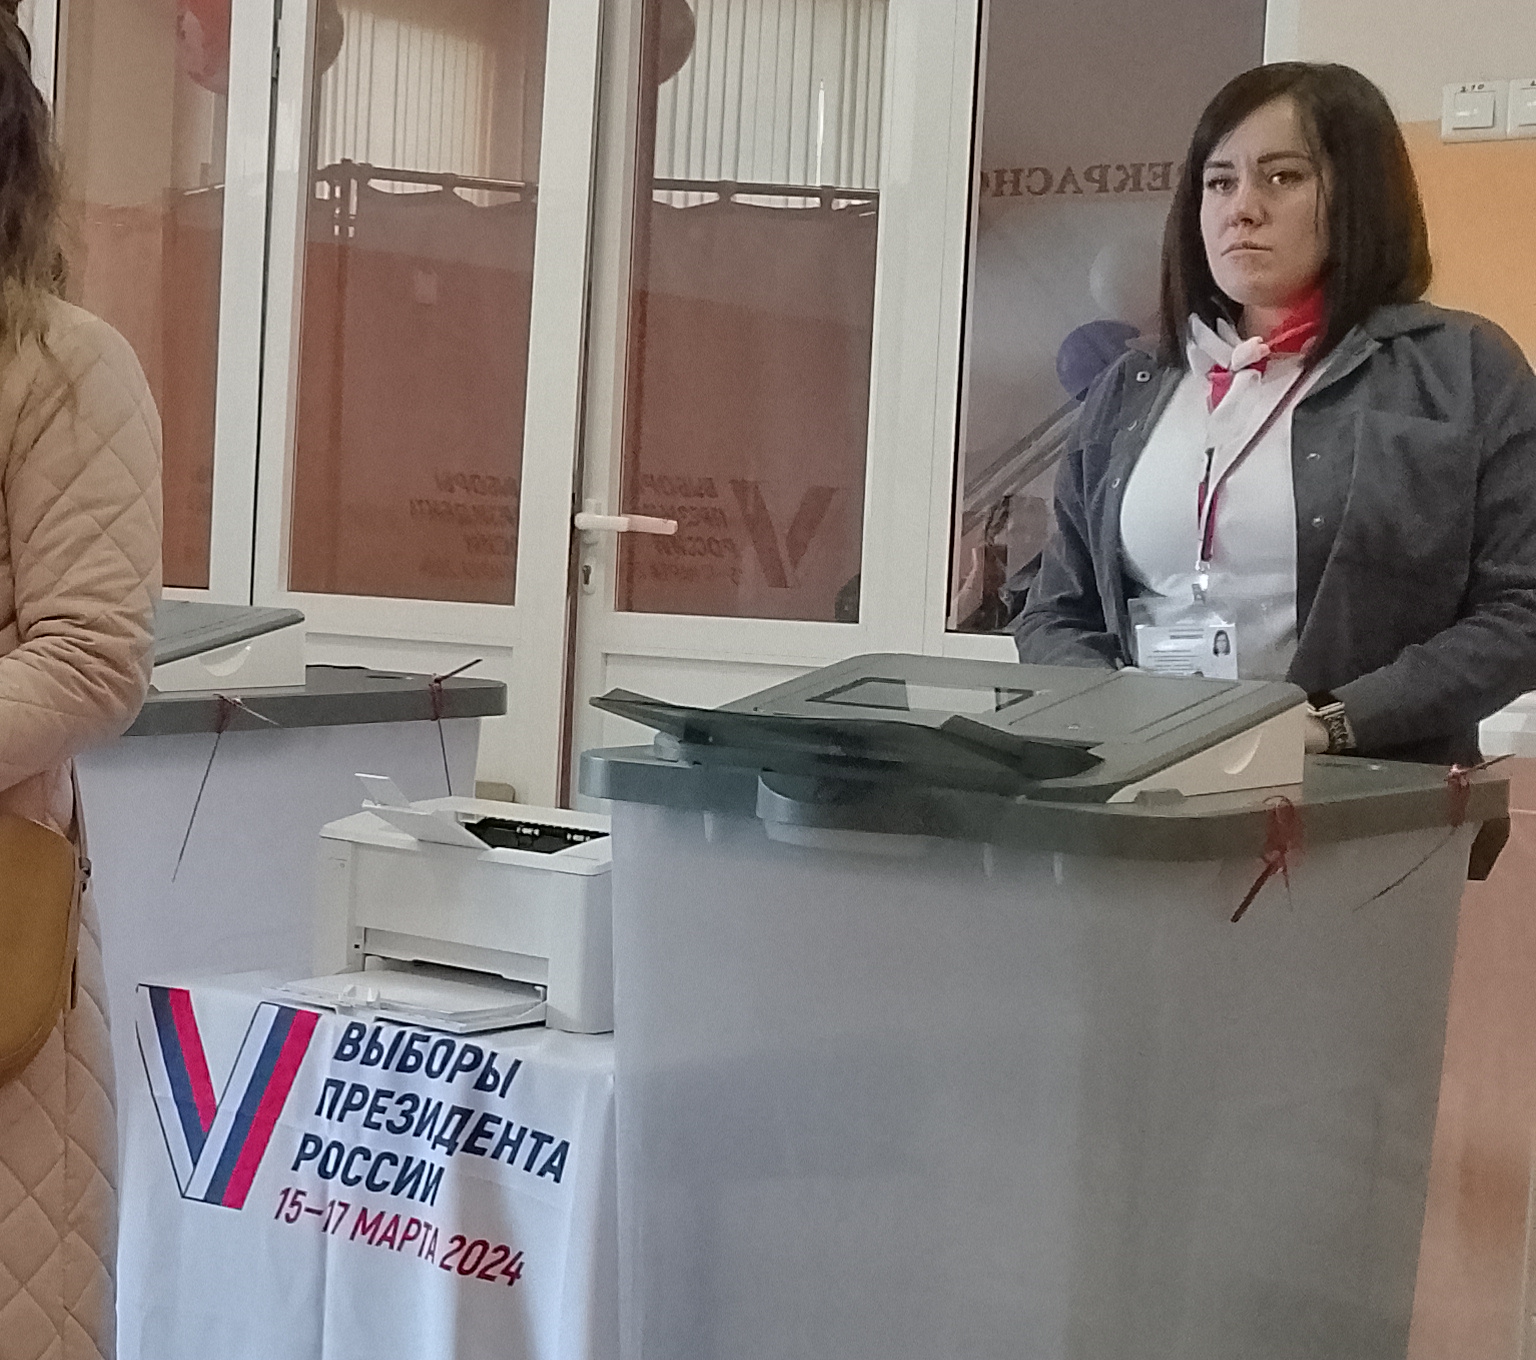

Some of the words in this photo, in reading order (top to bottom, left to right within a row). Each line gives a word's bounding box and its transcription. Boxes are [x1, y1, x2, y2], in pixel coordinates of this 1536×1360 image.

[333, 1021, 523, 1098] ВЫБОРЫ
[291, 1132, 445, 1207] РОССИИ
[314, 1078, 570, 1184] ПРЕЗИДЕНТА
[349, 1206, 440, 1264] МАРТА
[439, 1234, 525, 1286] 2024
